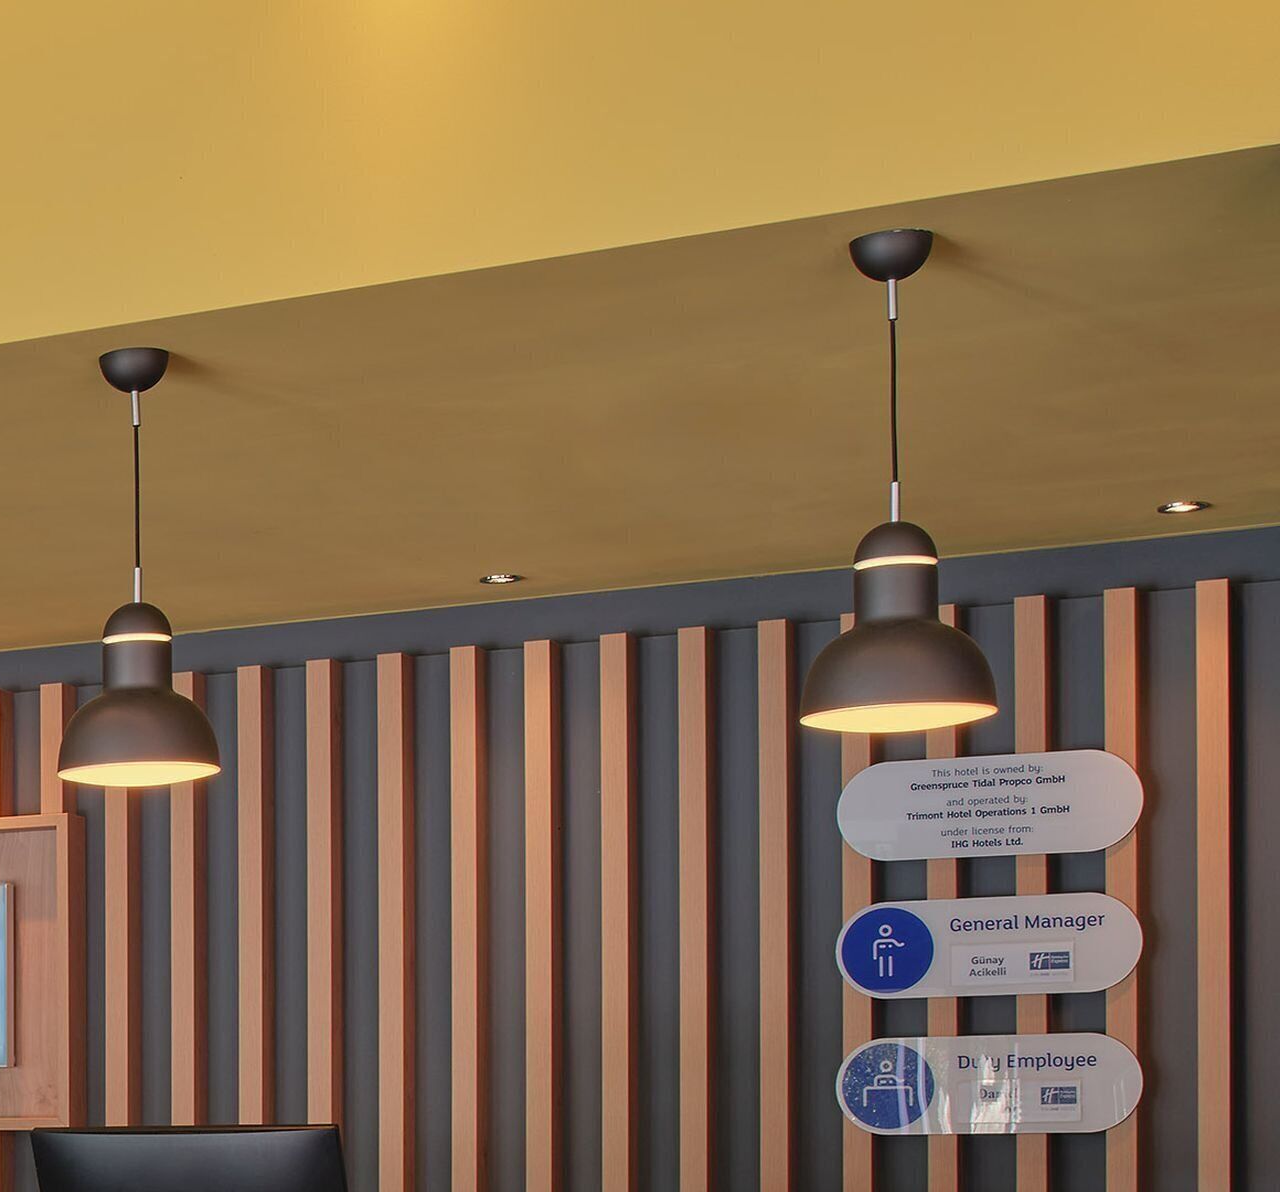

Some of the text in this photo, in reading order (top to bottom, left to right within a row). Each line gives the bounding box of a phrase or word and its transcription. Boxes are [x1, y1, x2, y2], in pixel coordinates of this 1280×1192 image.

[932, 764, 1044, 777] This hotel is owned by:
[910, 776, 1065, 791] Greenspruce Tidal Propco GmbH
[946, 795, 1028, 807] and operated by:
[906, 812, 944, 820] Trimont
[947, 810, 972, 819] Hotel
[975, 808, 1027, 818] Operations
[1040, 805, 1070, 814] GmbH
[940, 825, 1034, 837] under license from:
[951, 838, 1023, 848] IHG Hotels Ltd.
[950, 914, 1105, 933] General Manager
[971, 956, 1004, 966] Günay
[969, 967, 1006, 976] Acikelli
[1007, 1052, 1096, 1071] Employee
